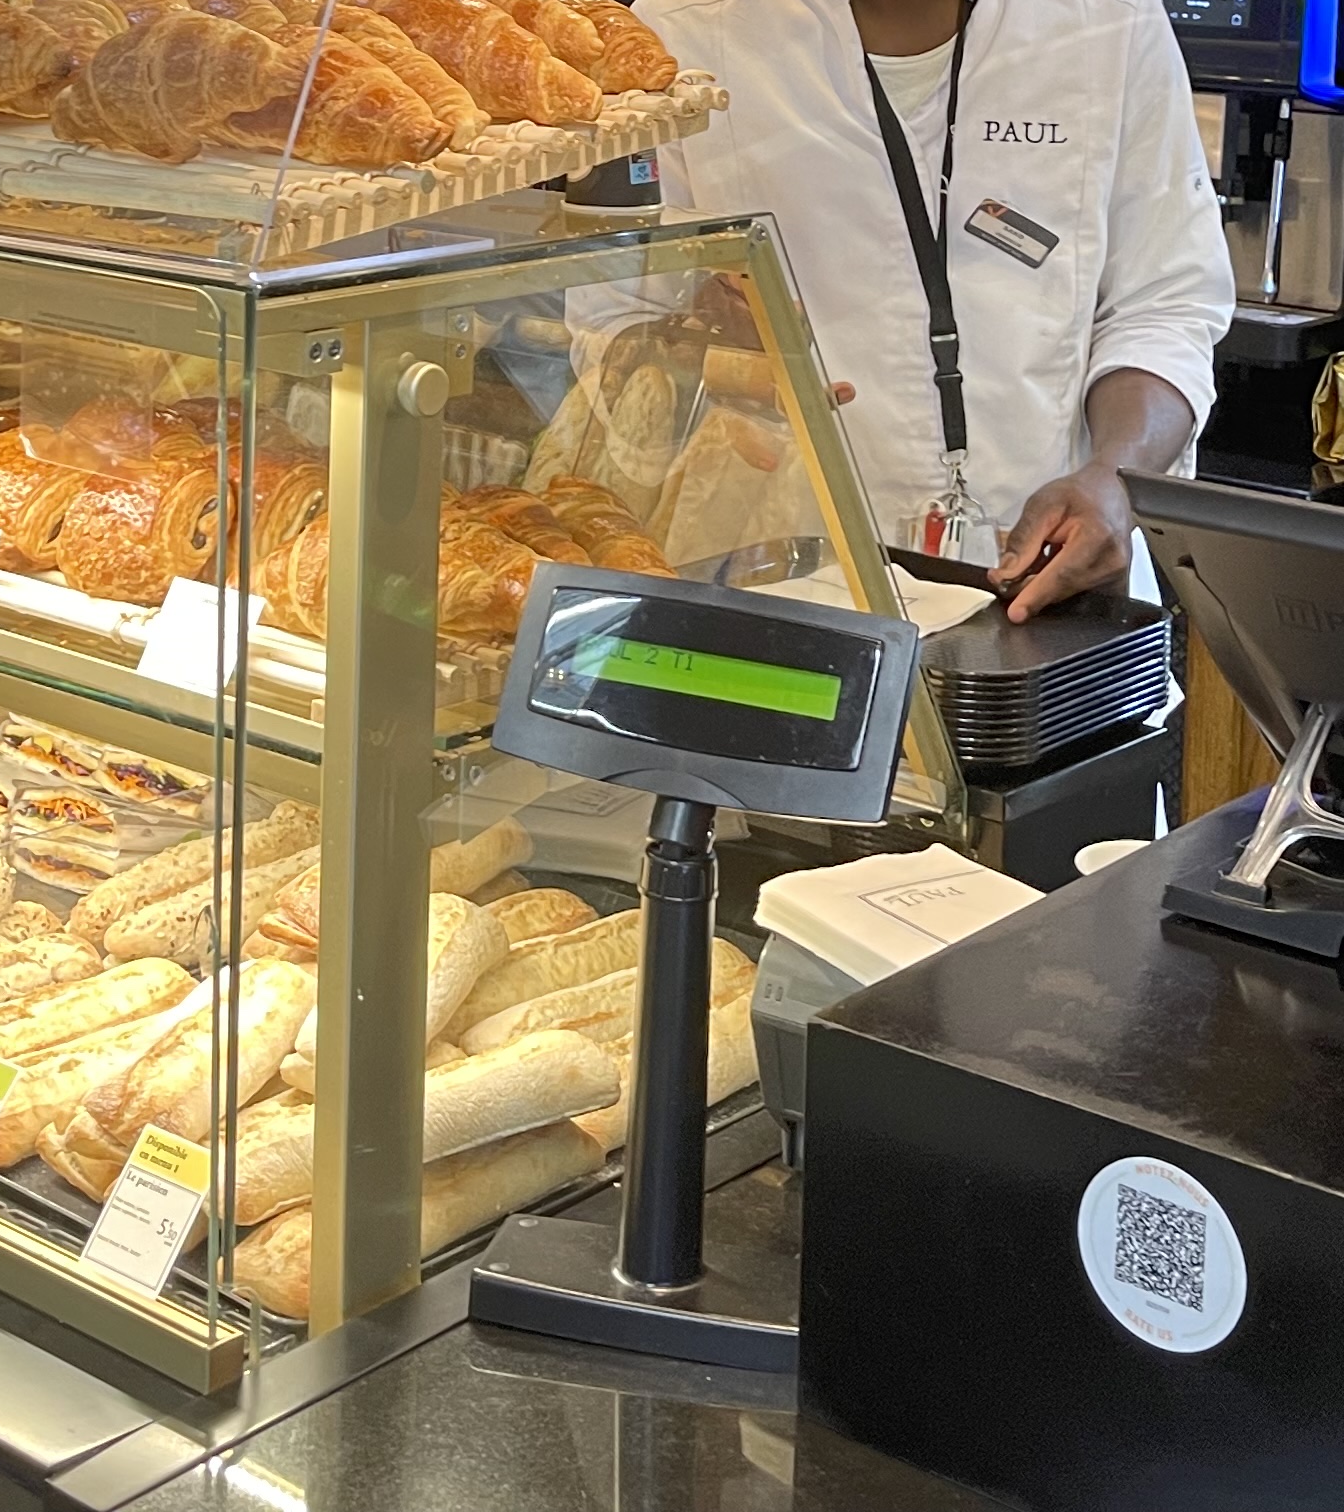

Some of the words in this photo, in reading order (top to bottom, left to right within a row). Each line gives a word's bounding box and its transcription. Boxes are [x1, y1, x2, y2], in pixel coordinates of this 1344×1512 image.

[983, 121, 1068, 144] PAUL
[644, 646, 657, 665] 2
[889, 886, 966, 908] PAUL
[145, 1134, 188, 1161] Disponible
[150, 1155, 172, 1171] menu
[126, 1170, 136, 1182] Le
